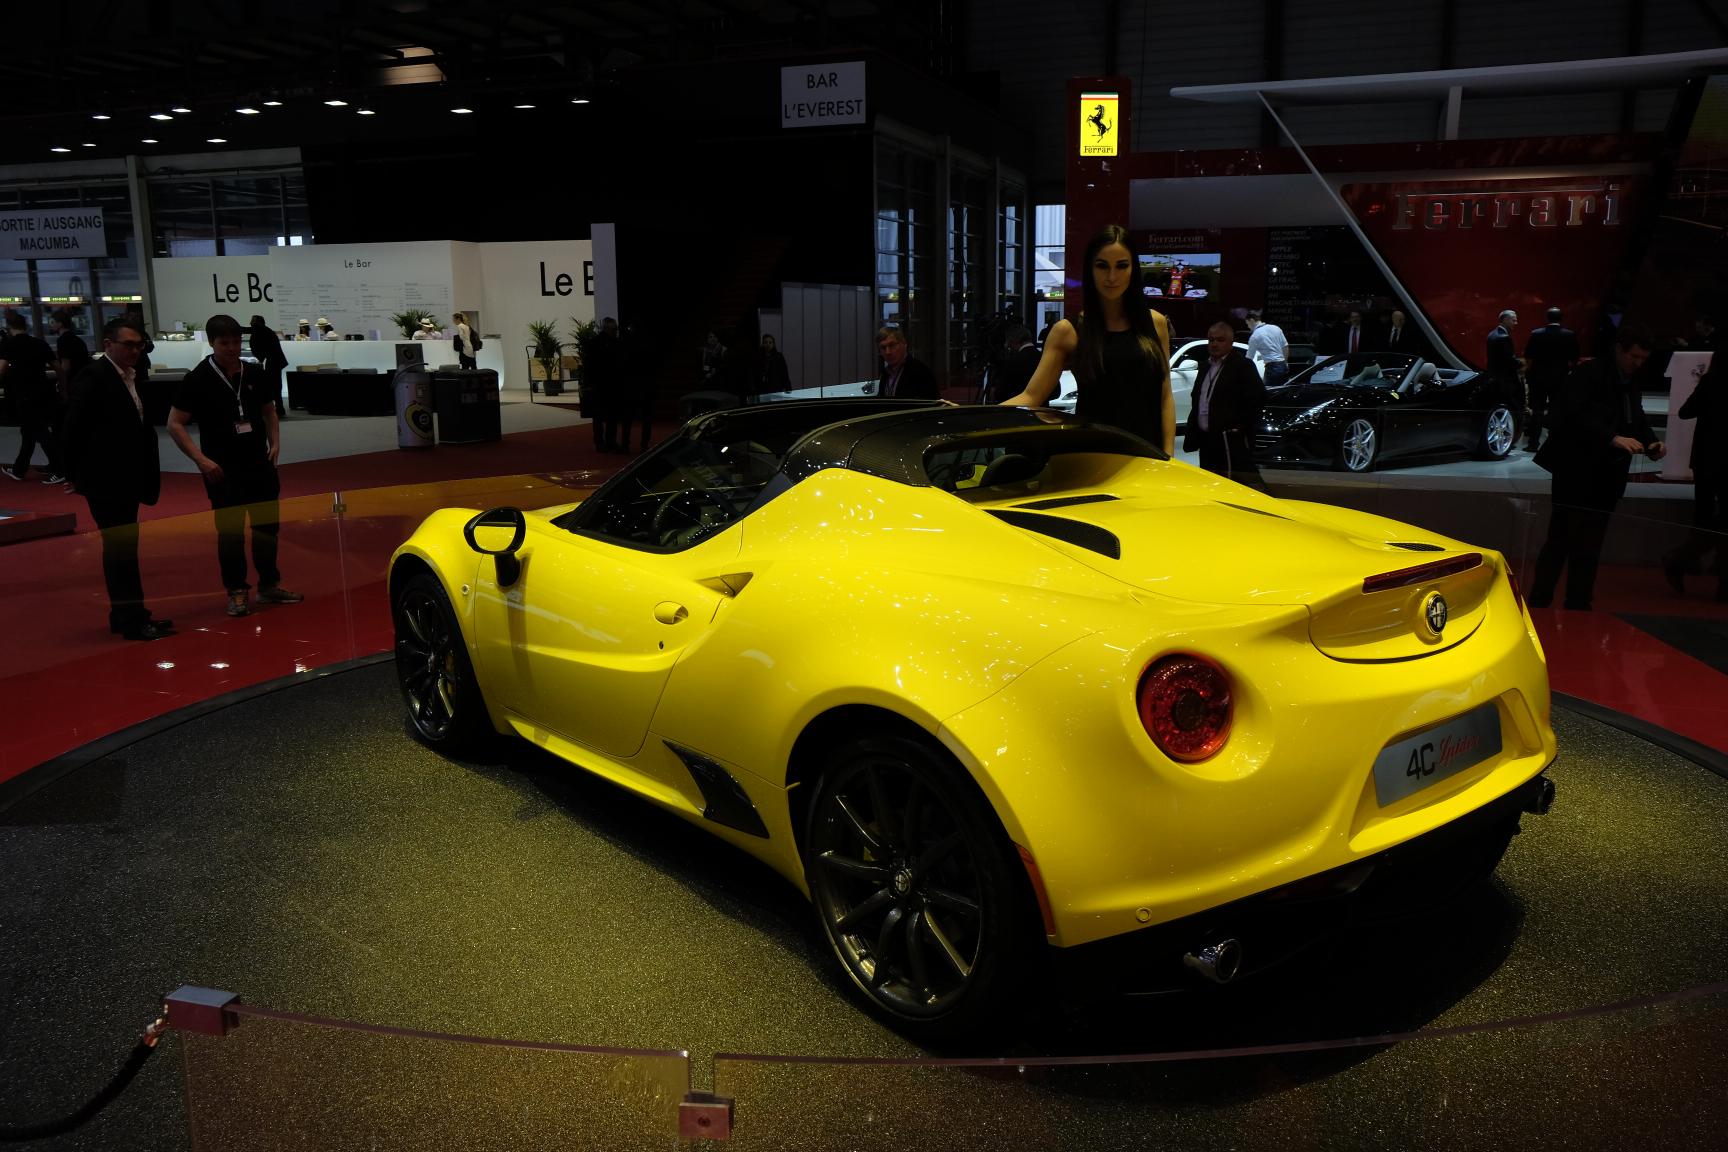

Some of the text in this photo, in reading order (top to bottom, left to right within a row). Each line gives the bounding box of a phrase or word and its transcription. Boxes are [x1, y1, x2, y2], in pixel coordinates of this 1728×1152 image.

[807, 72, 838, 89] BAR
[784, 99, 863, 119] L'EVEREST
[1084, 145, 1113, 153] Ferrari
[1393, 183, 1625, 231] Ferrari
[0, 217, 35, 232] ORTIE
[44, 215, 102, 230] AUSGANG
[20, 236, 80, 251] MACUMBA
[344, 259, 372, 269] Le Bar
[540, 261, 573, 296] Le
[212, 273, 240, 303] Le
[1406, 742, 1436, 780] 4C
